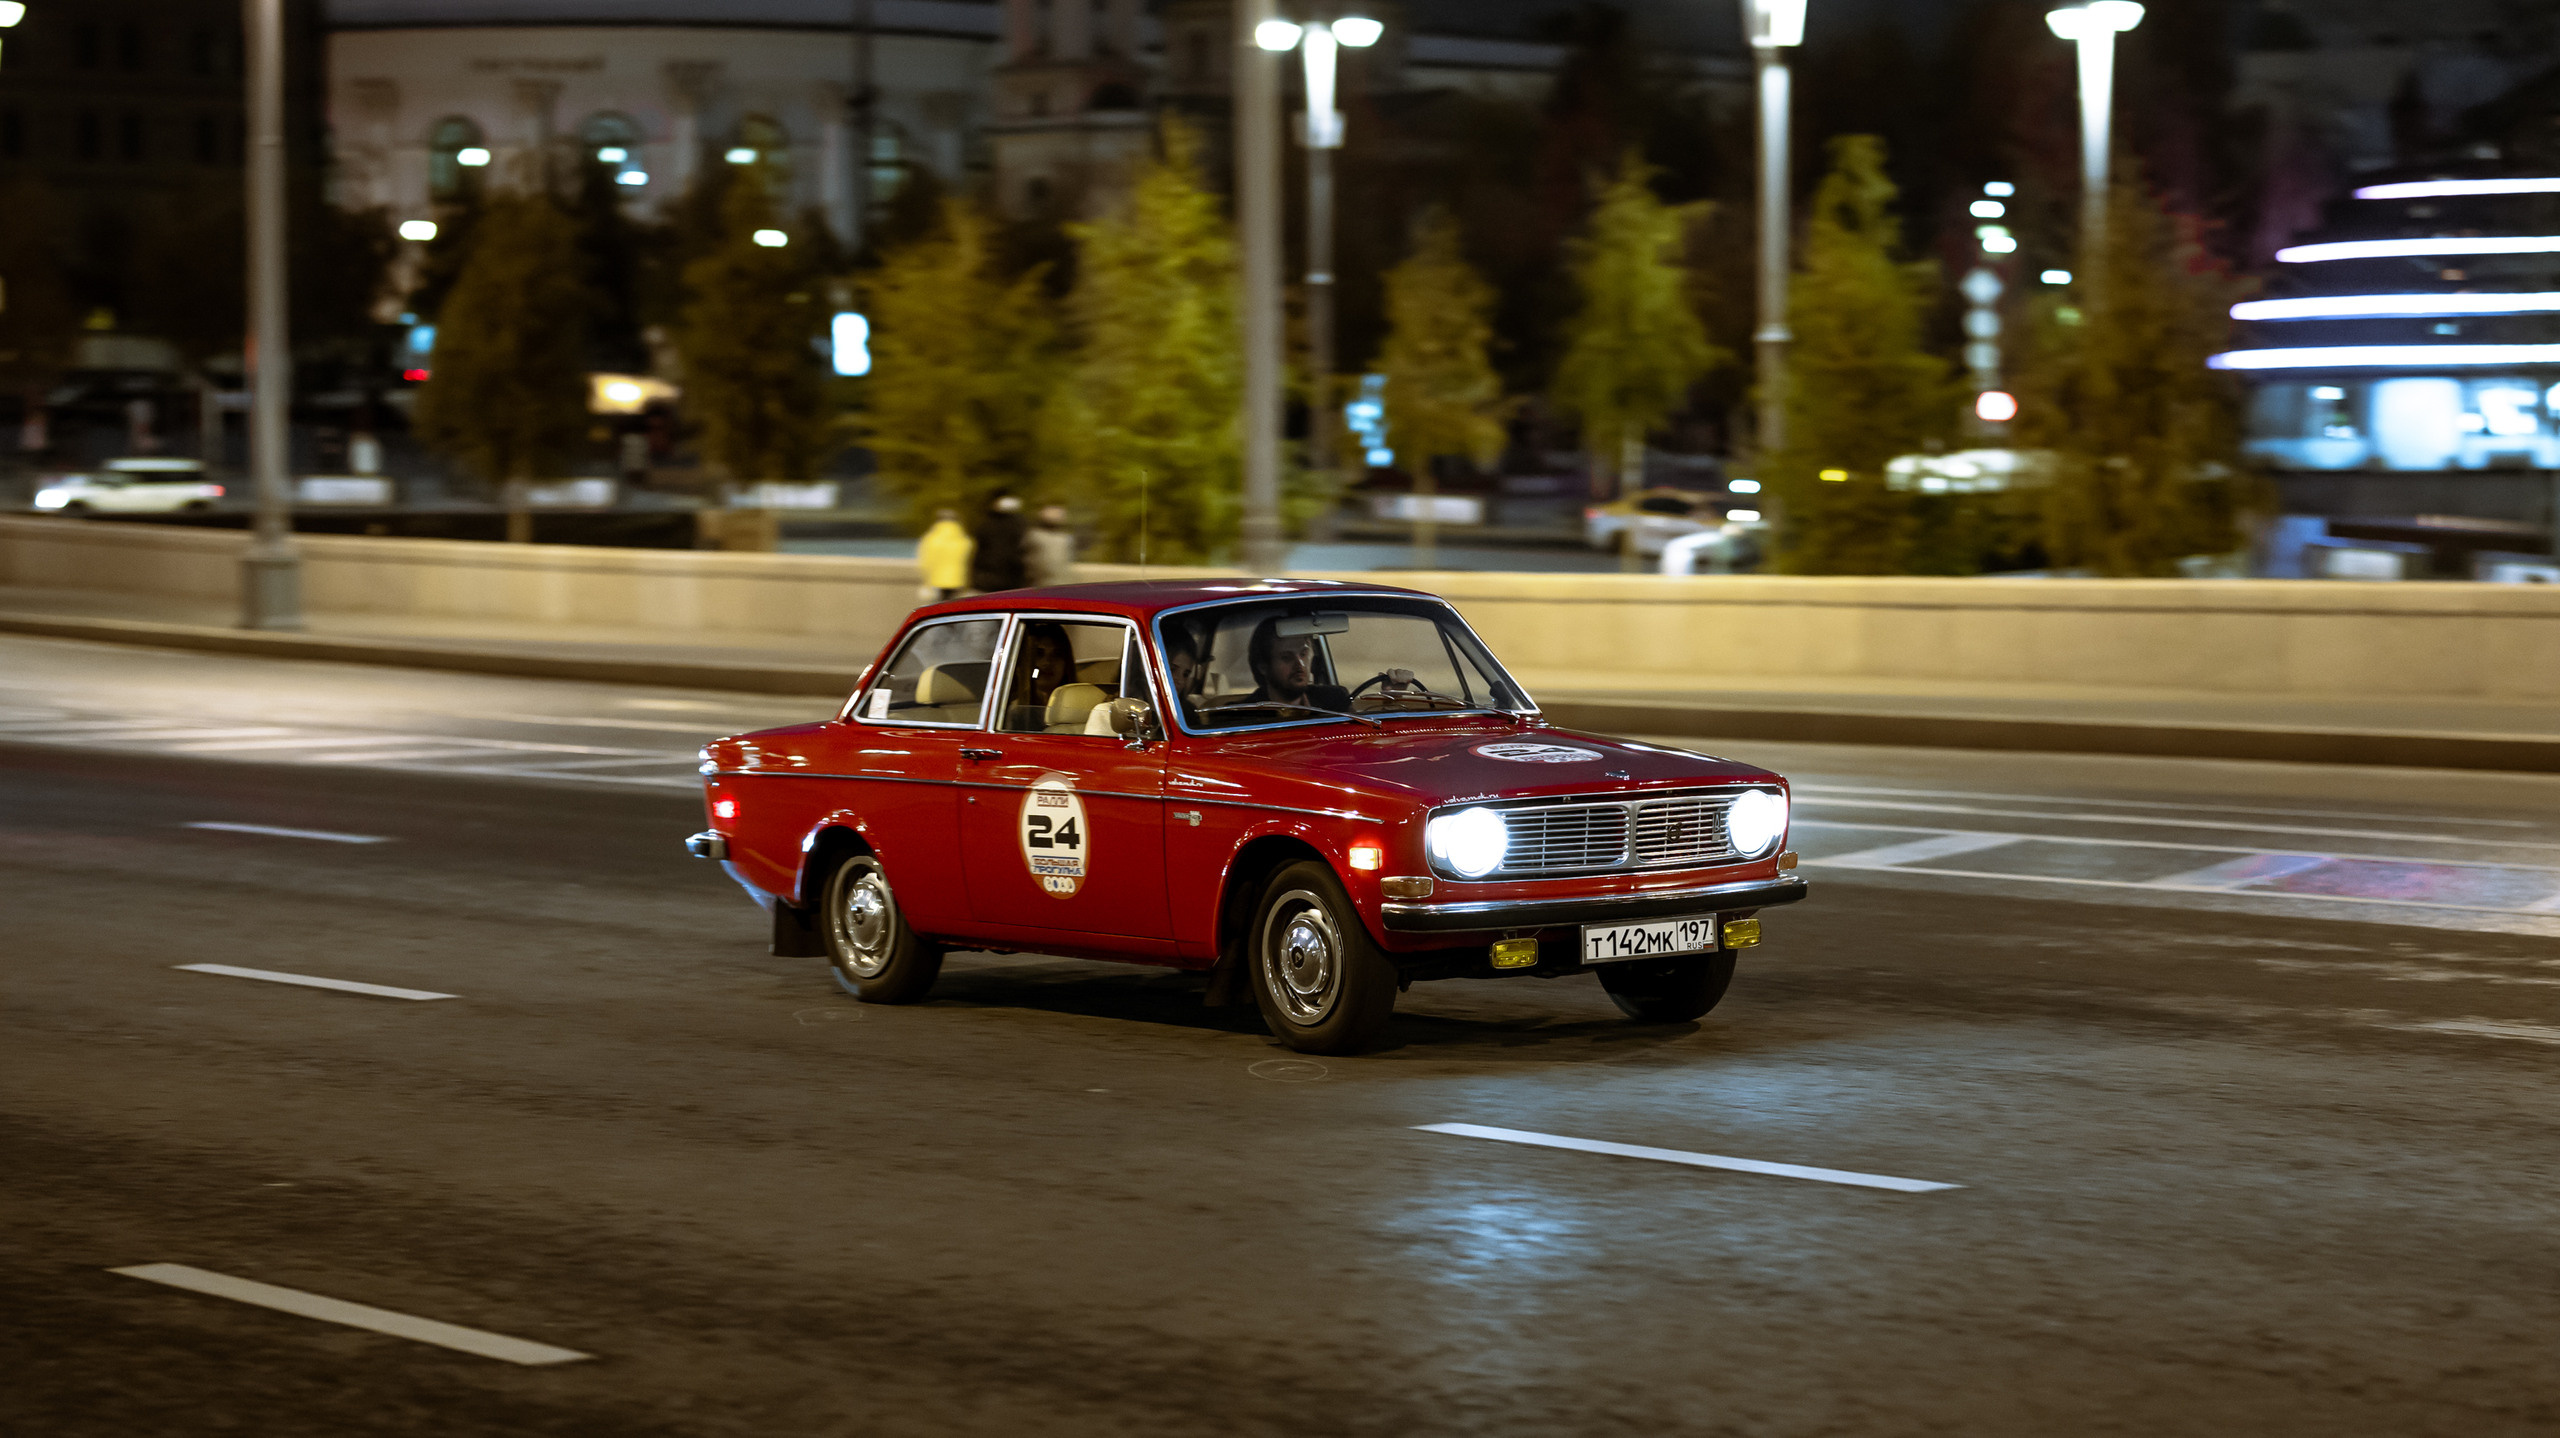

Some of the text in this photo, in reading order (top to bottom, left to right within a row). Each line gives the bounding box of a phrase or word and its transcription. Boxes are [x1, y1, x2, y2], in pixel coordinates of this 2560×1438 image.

[1028, 815, 1081, 849] 24
[1679, 920, 1709, 942] 197
[1686, 942, 1703, 950] RUS
